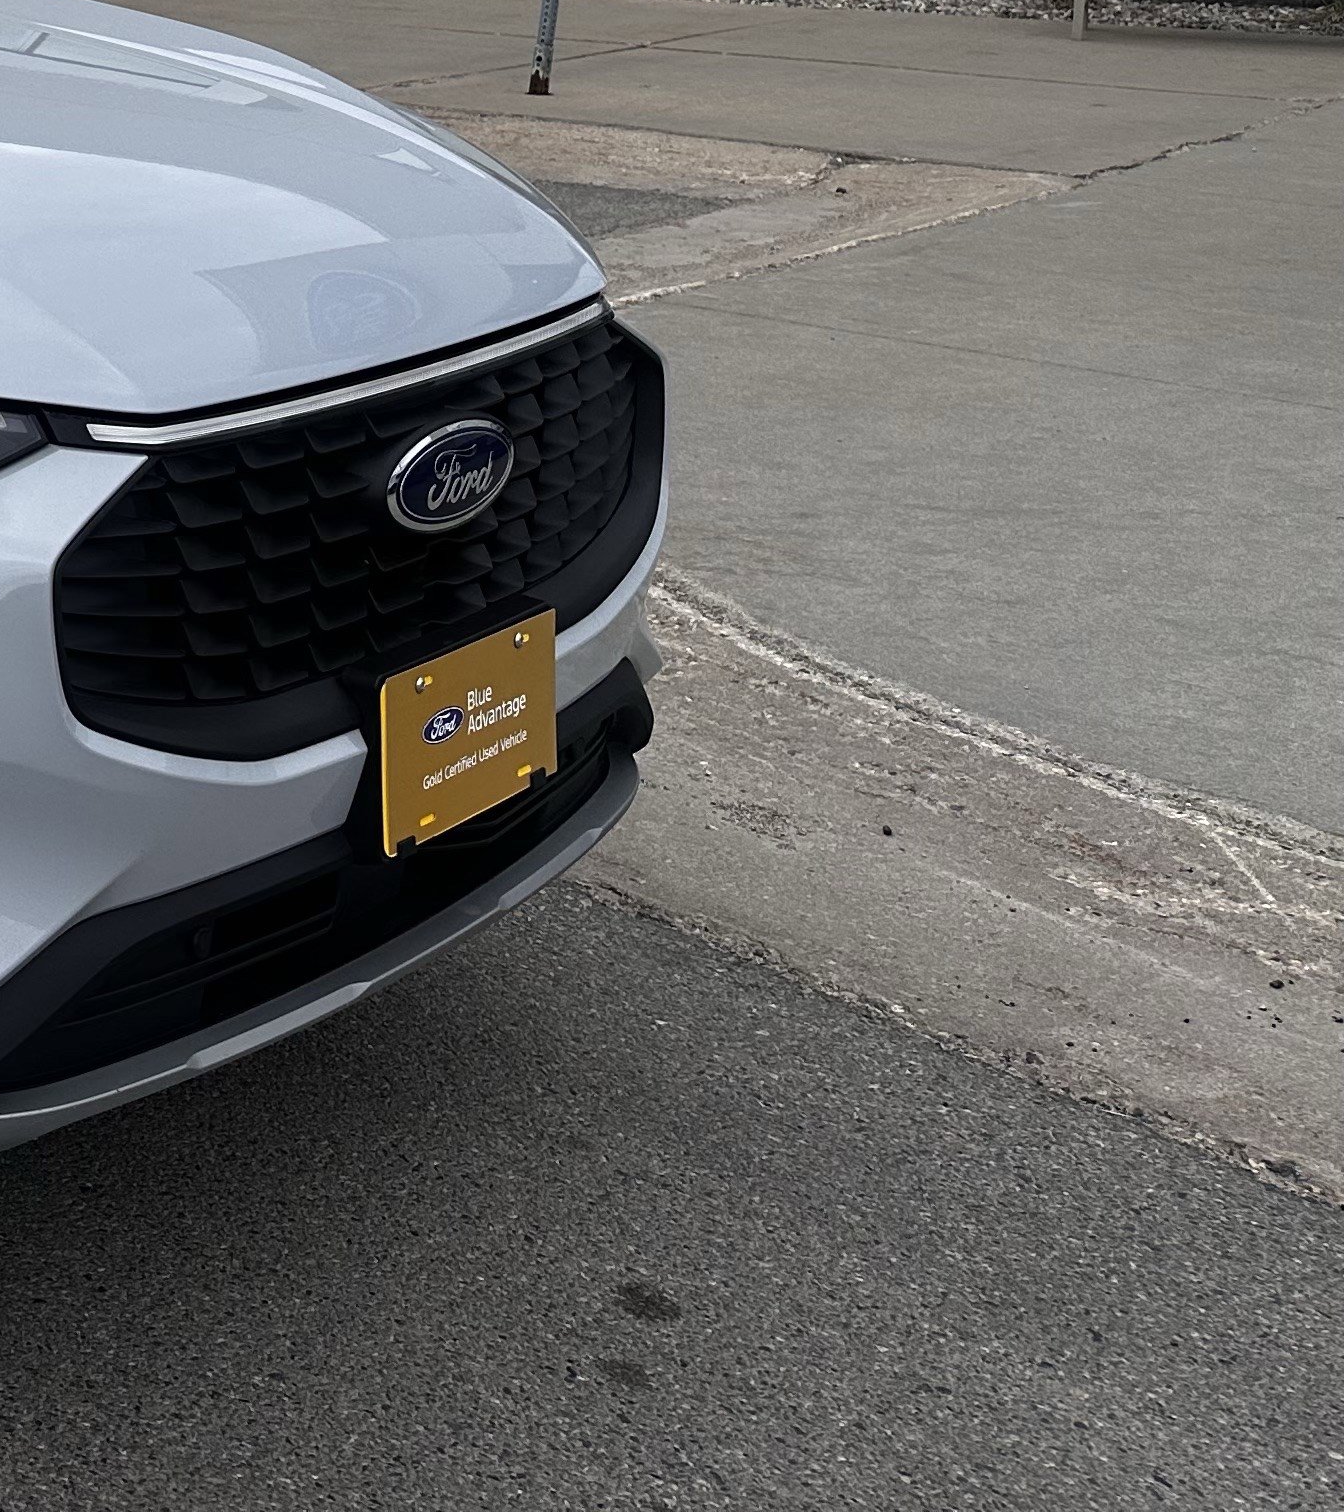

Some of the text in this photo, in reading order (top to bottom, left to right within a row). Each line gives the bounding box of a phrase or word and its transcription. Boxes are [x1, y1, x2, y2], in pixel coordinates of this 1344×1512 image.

[426, 442, 494, 512] Ford
[467, 686, 493, 711] Blue
[467, 694, 527, 736] Advantage
[430, 711, 457, 740] Ford
[422, 729, 528, 790] Gold Certified Used Vehicle
